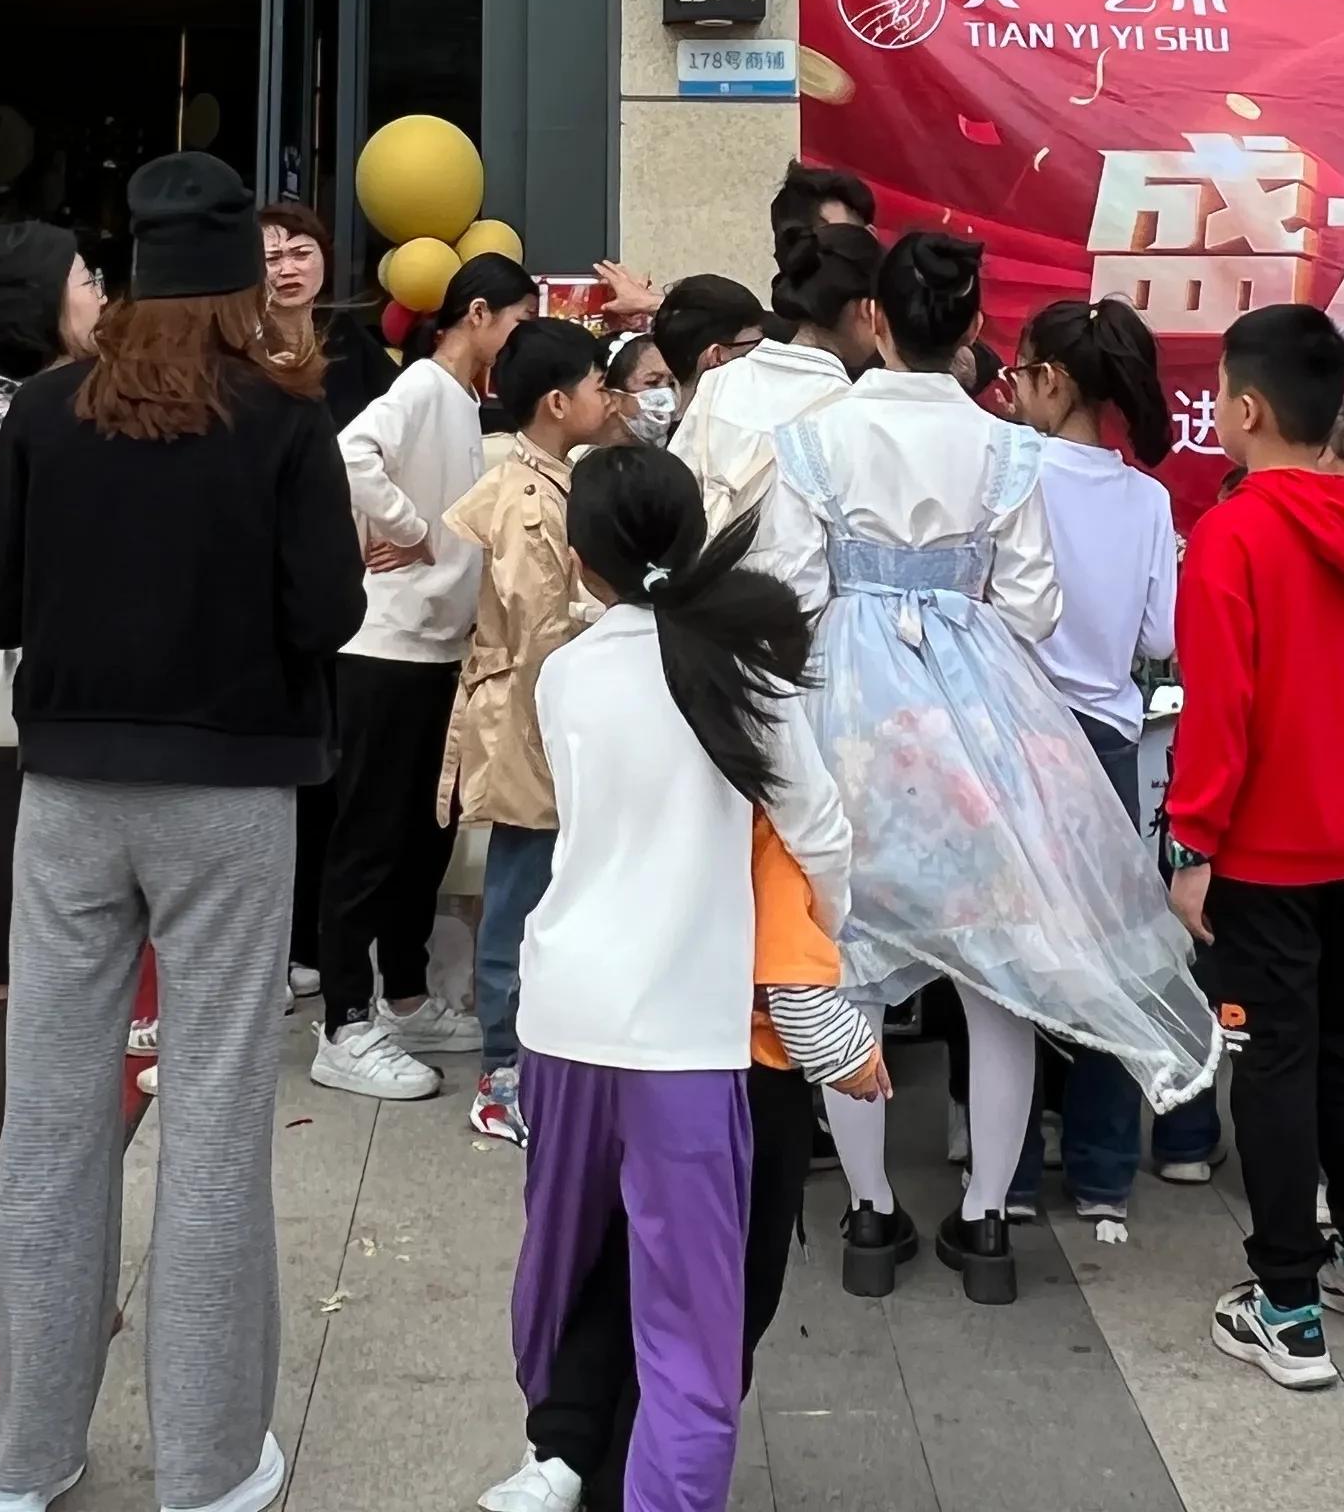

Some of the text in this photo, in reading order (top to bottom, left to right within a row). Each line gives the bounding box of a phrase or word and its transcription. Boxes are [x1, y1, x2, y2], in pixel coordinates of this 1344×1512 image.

[963, 21, 1230, 52] TIAN YI YI SHU
